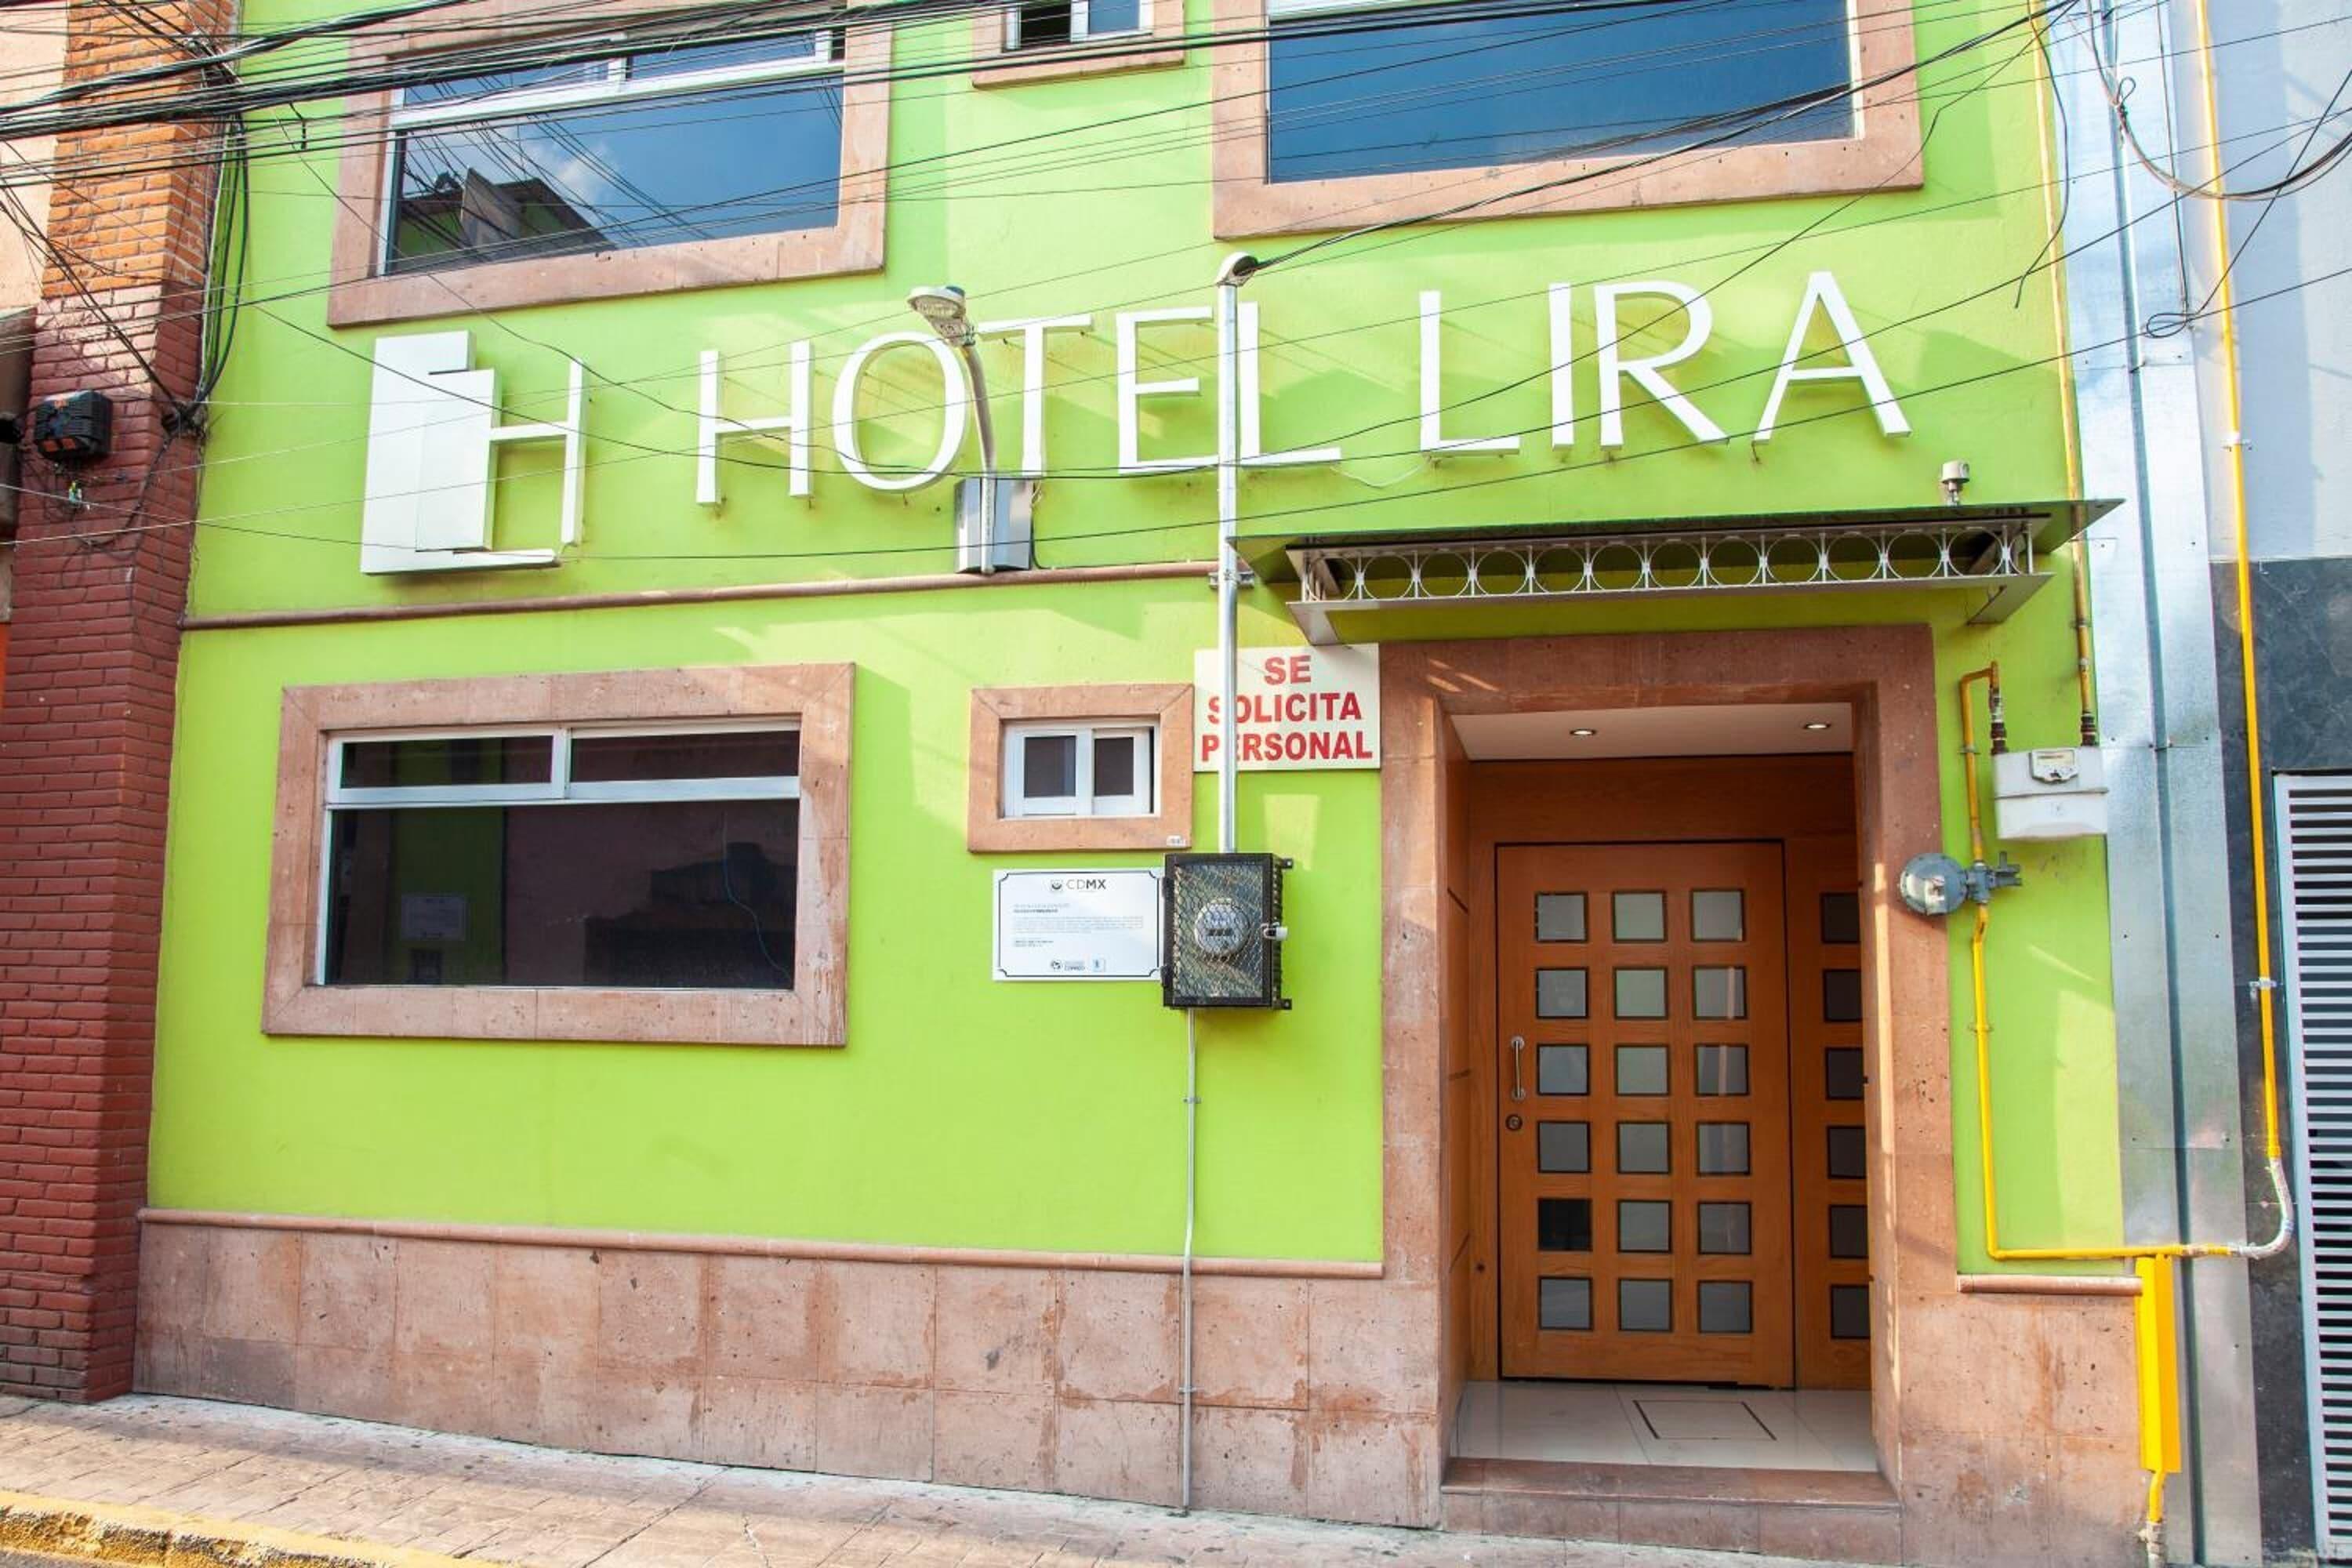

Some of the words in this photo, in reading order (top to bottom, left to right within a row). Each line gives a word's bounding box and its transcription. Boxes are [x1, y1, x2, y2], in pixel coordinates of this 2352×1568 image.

[696, 302, 1341, 506] HOTEL
[1419, 270, 1912, 456] LIRA
[1263, 655, 1312, 685] SE
[1201, 731, 1374, 762] PRSONAL
[1066, 879, 1106, 890] CDMX
